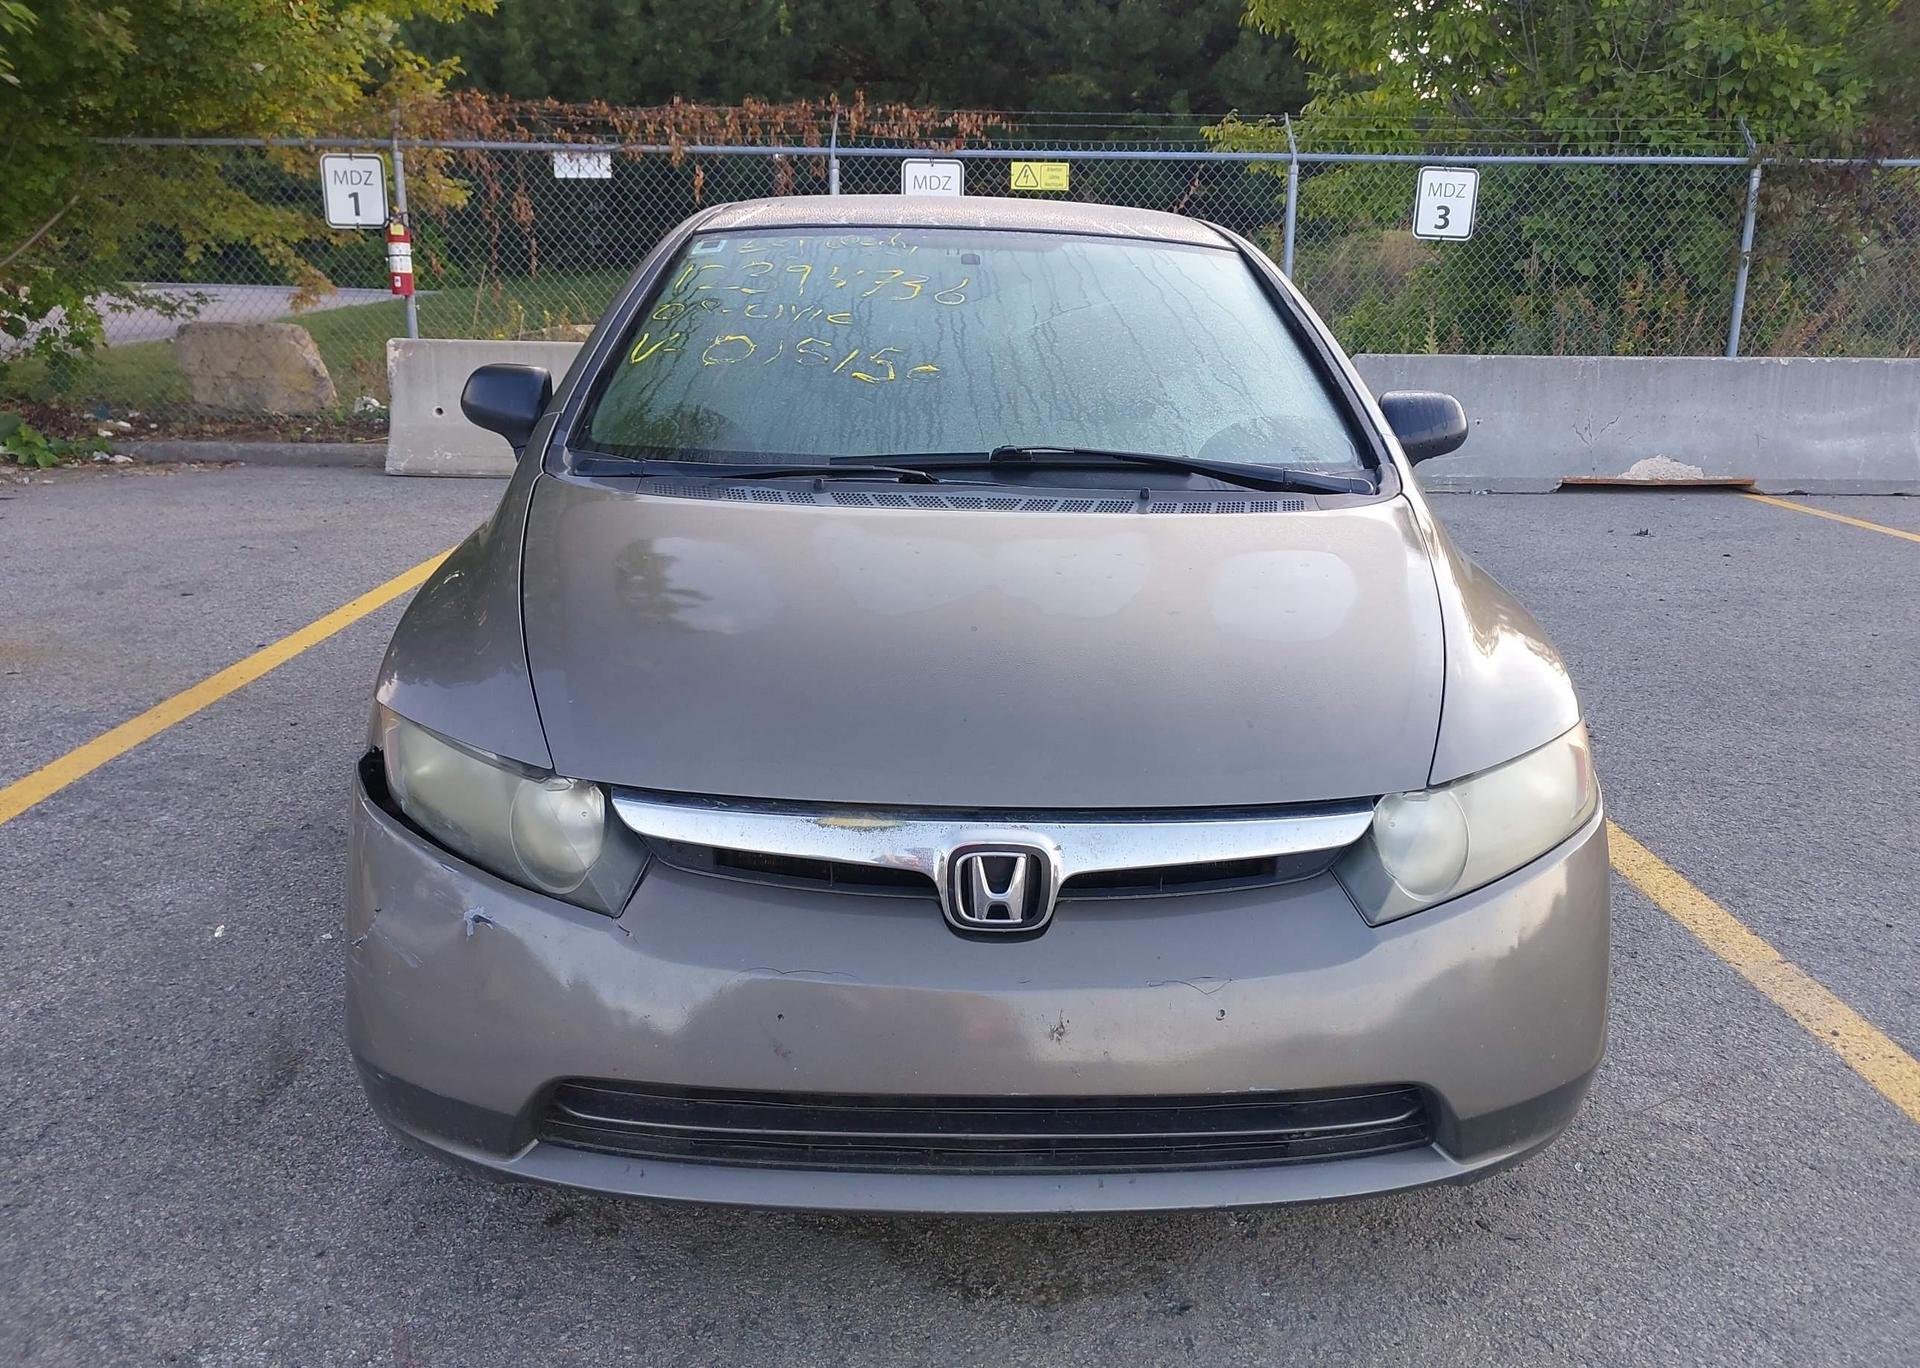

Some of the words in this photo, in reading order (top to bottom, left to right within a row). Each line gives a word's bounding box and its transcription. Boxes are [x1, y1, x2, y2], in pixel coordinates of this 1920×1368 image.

[333, 169, 374, 186] MDZ
[912, 175, 952, 191] MDZ
[1427, 182, 1467, 199] MDZ
[348, 191, 361, 217] 1
[1433, 204, 1451, 230] 3
